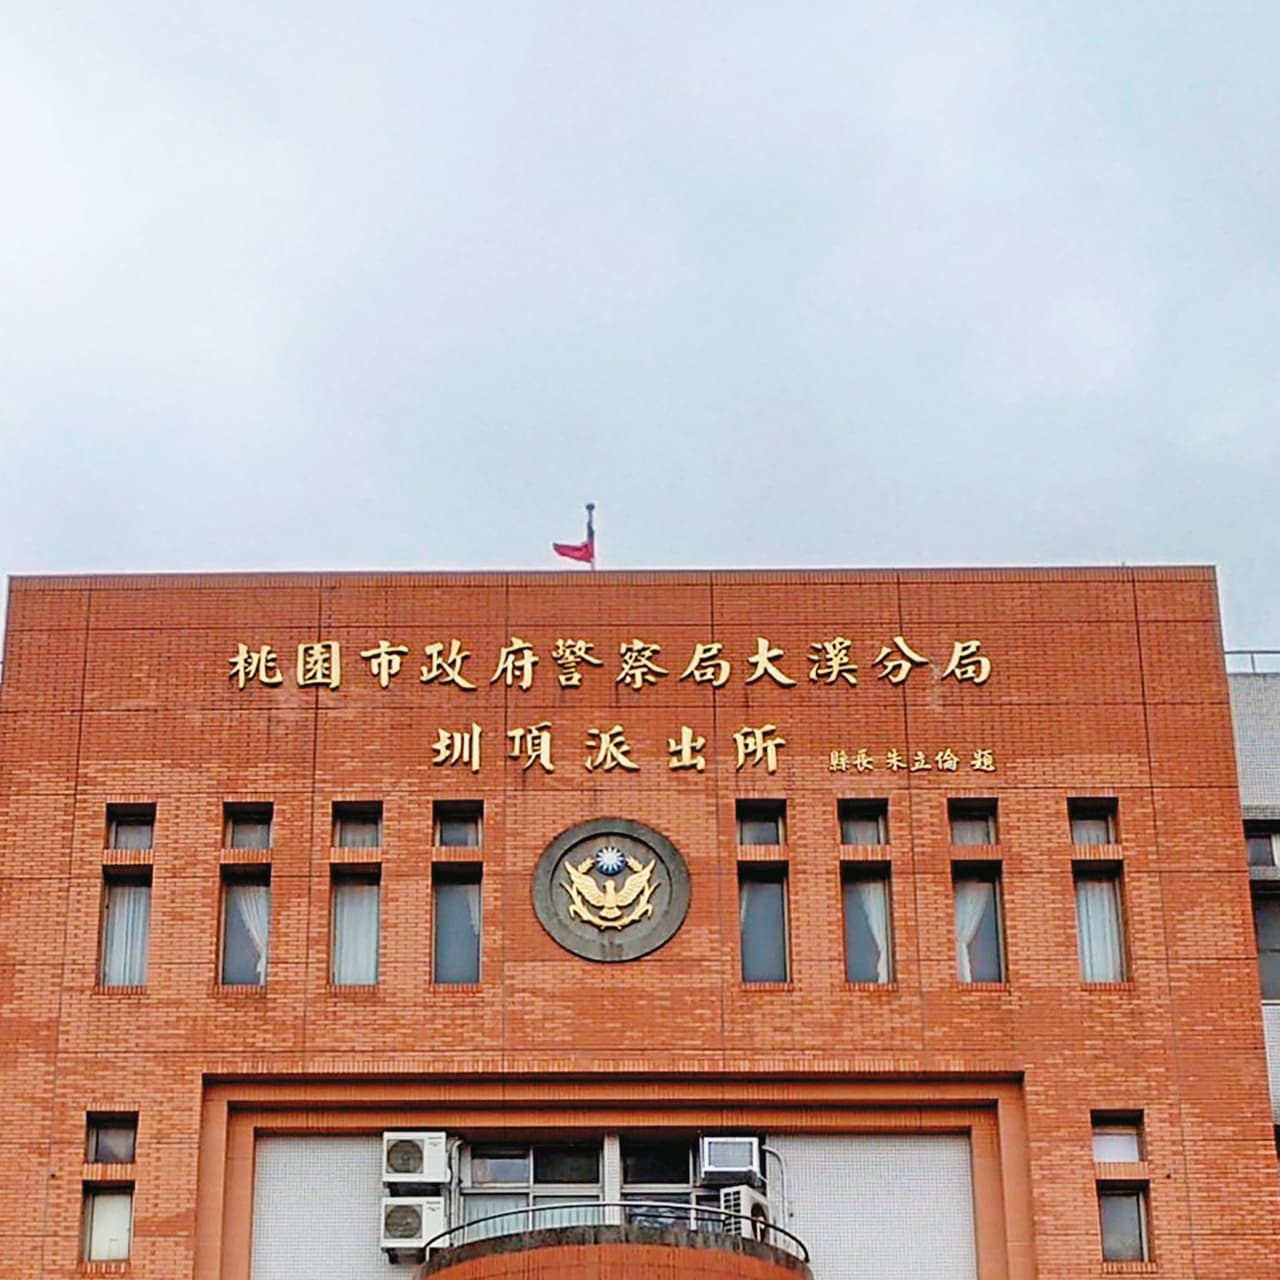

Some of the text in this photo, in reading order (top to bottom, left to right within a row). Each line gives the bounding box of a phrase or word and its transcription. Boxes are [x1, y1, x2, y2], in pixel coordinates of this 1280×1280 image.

[227, 637, 994, 690] 桃園市政府警察局大溪分局
[431, 722, 787, 774] 圳頂派出所
[829, 749, 875, 772] 縣長
[885, 747, 962, 772] 朱立倫
